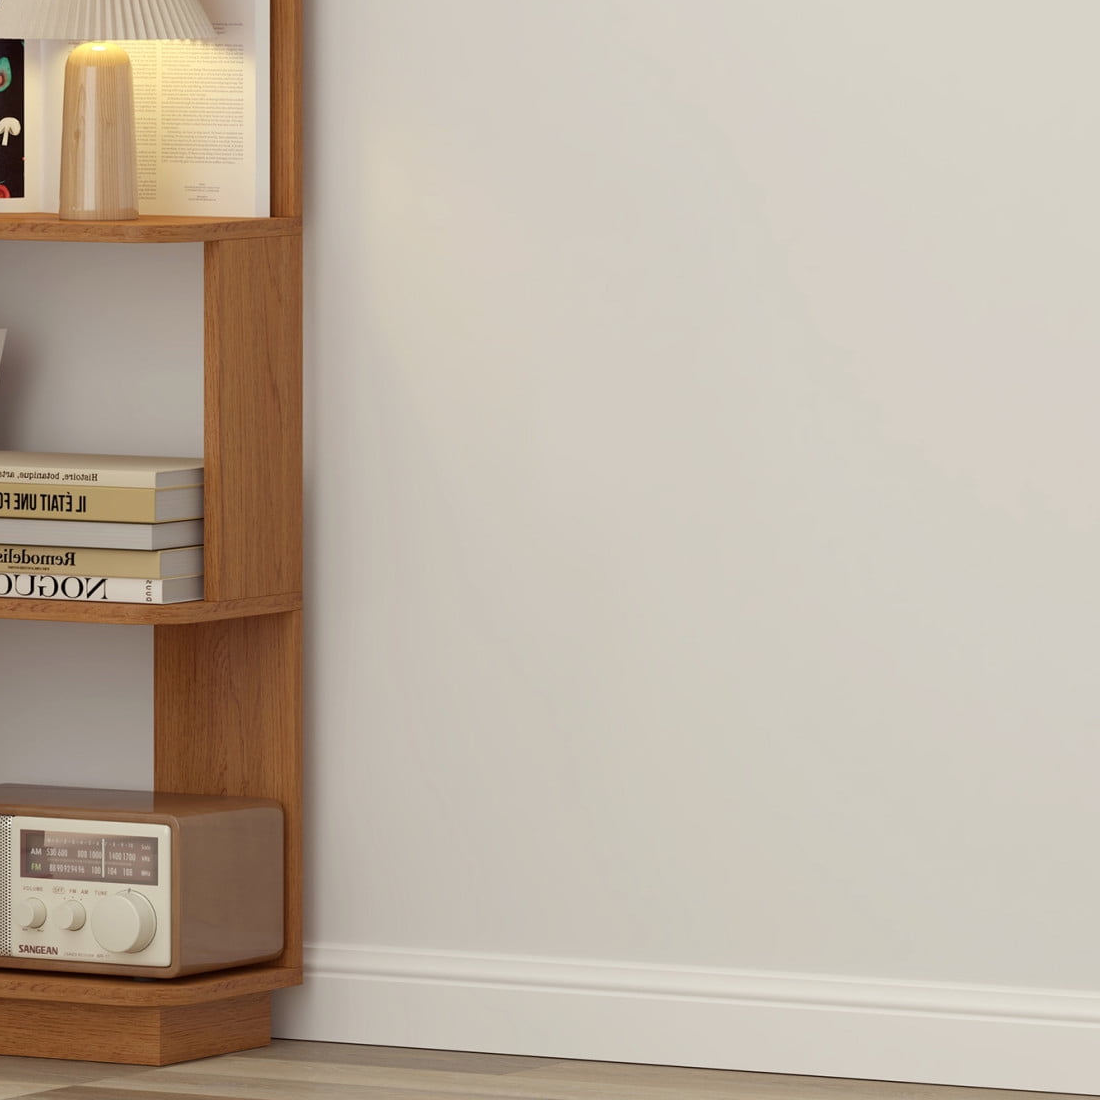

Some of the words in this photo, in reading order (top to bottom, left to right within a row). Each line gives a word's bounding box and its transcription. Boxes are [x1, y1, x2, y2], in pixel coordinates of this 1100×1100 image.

[30, 848, 42, 856] AM
[30, 863, 42, 871] FM
[18, 944, 58, 955] SANGEAN
